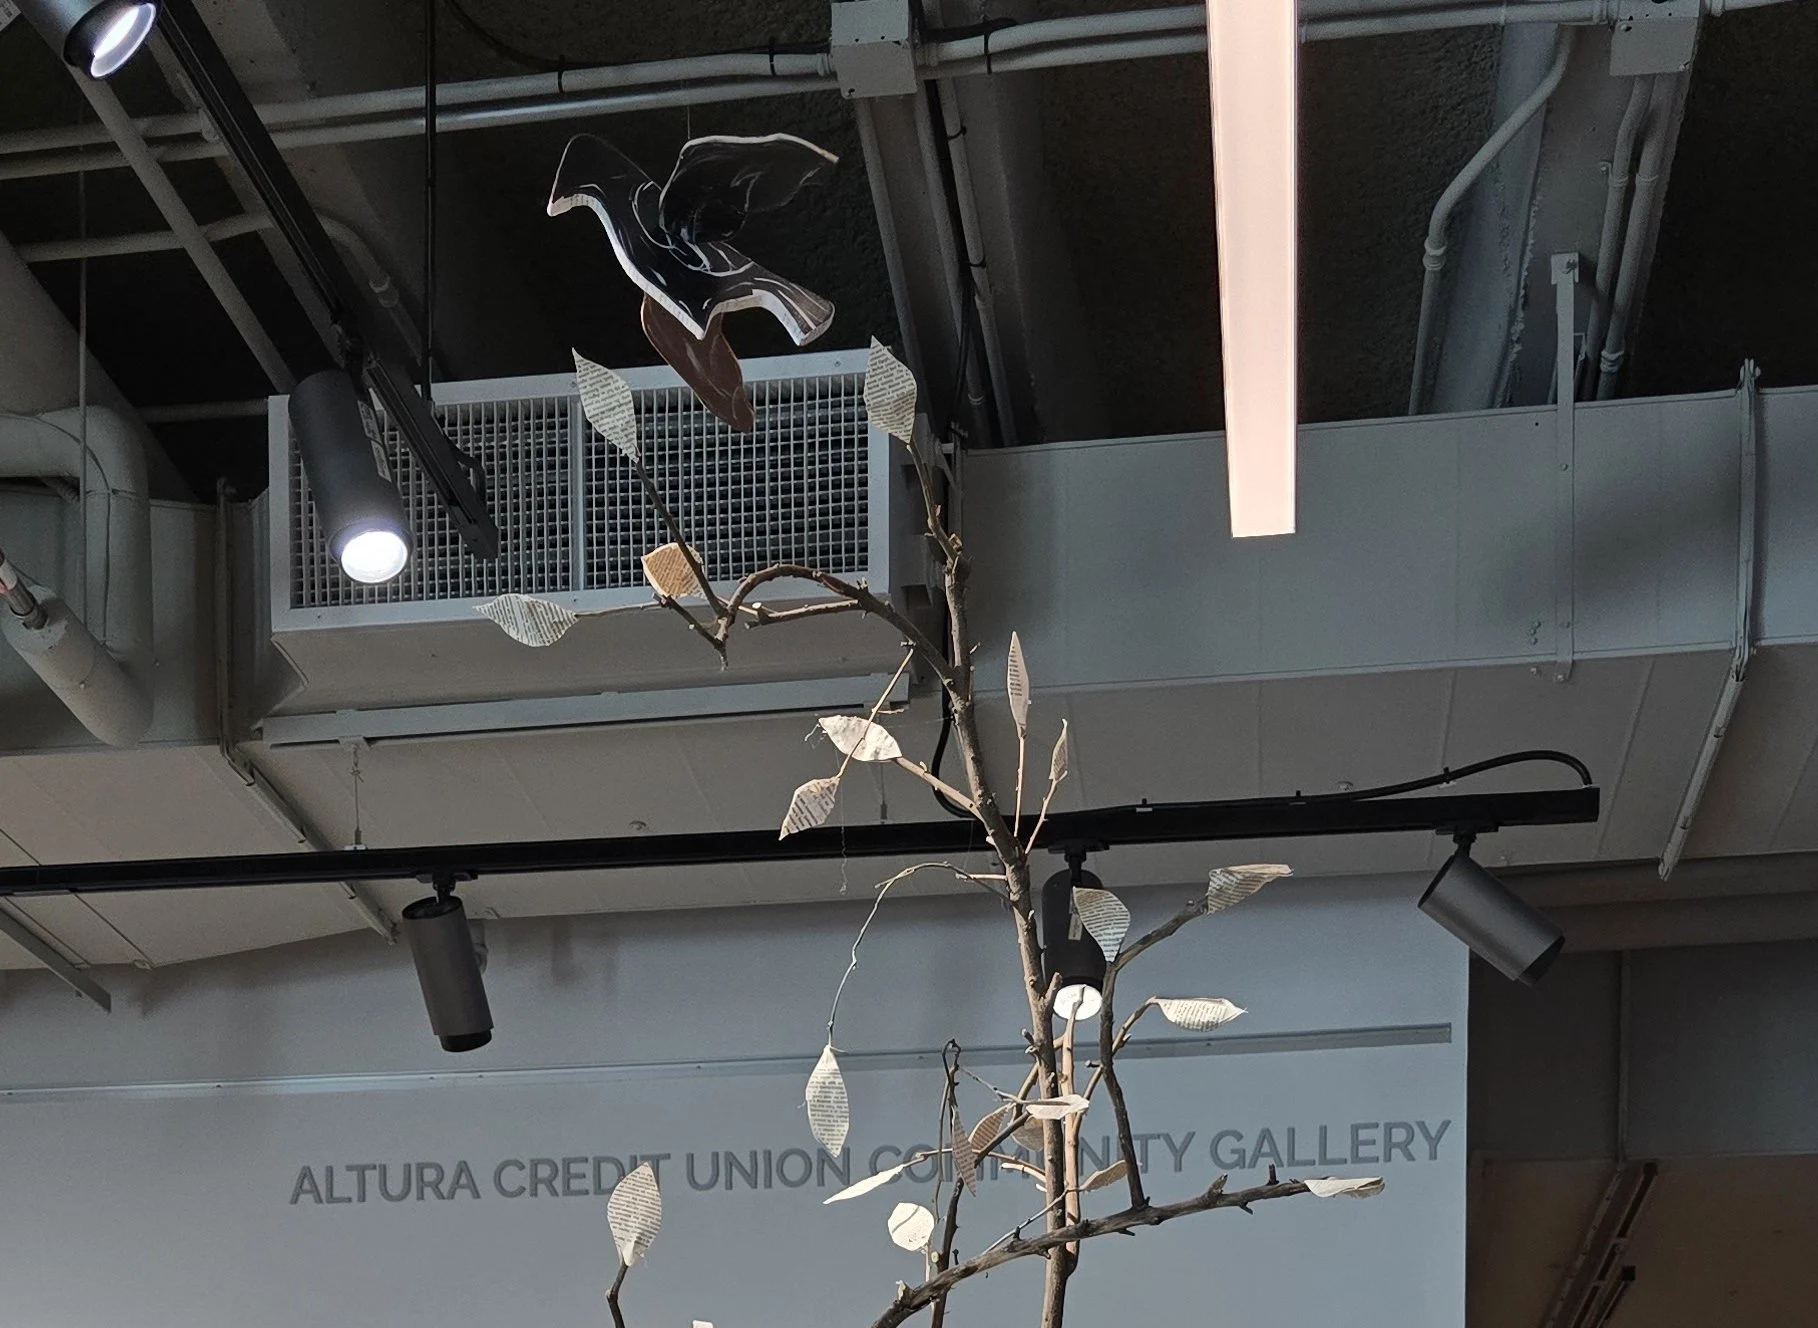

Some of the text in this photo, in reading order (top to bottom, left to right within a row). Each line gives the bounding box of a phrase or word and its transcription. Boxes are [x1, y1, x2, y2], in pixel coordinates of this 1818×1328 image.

[290, 1160, 481, 1205] ALTURA
[686, 1146, 852, 1191] UNION
[1209, 1119, 1453, 1171] GALLERY
